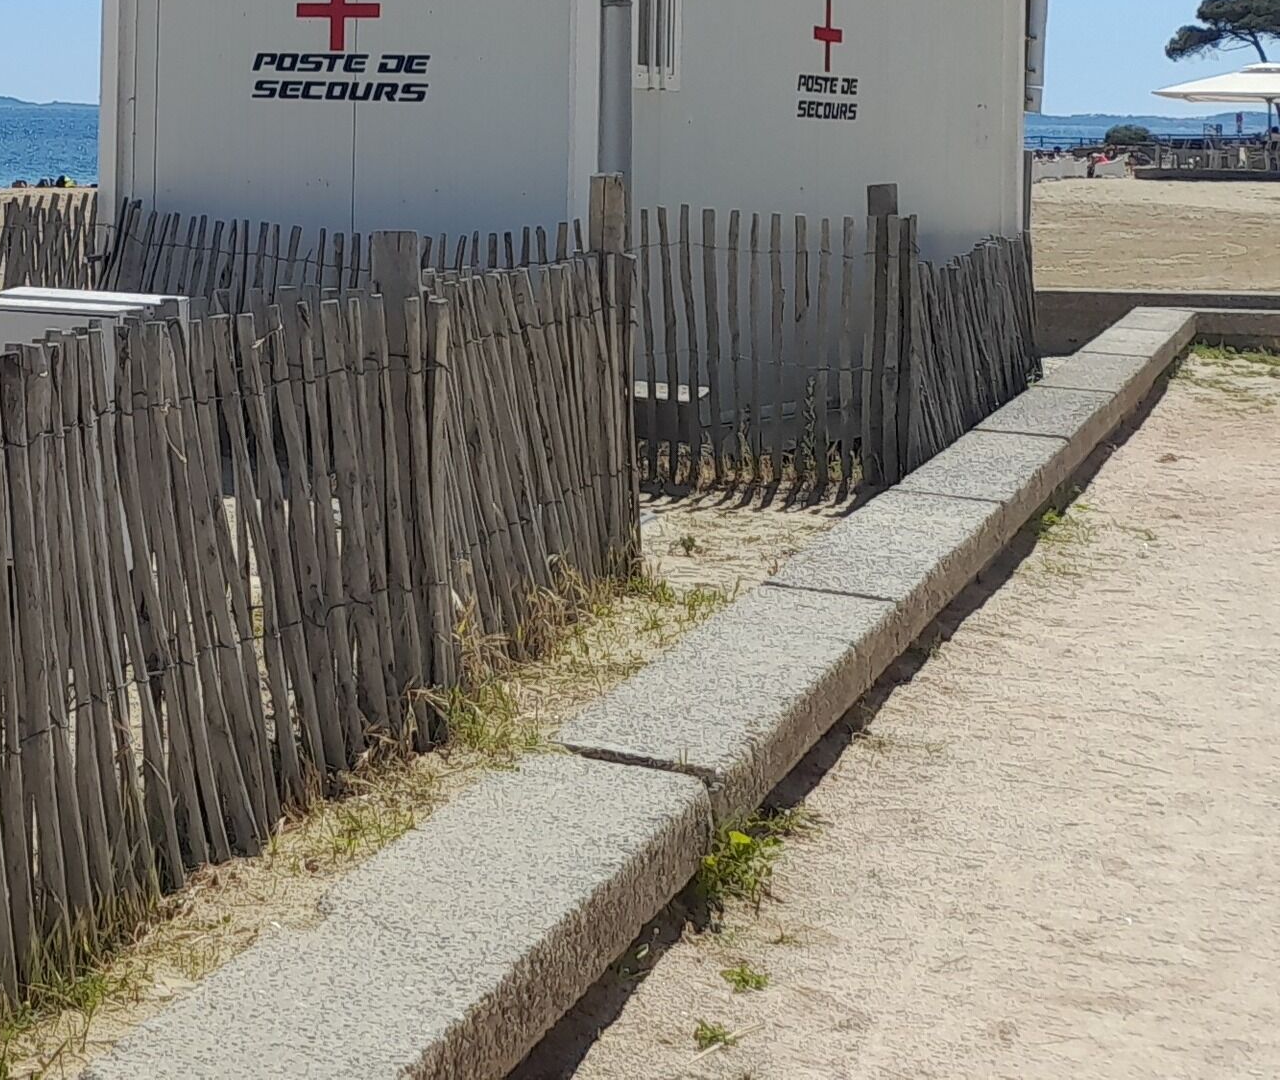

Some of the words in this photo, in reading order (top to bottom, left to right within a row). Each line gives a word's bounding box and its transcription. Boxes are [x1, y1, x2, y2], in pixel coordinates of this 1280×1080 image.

[252, 52, 369, 74] POSTE
[377, 54, 431, 74] DE
[251, 80, 429, 102] SECOURS
[797, 74, 839, 94] POSTE
[840, 77, 858, 95] DE
[796, 100, 858, 121] SECOURS
